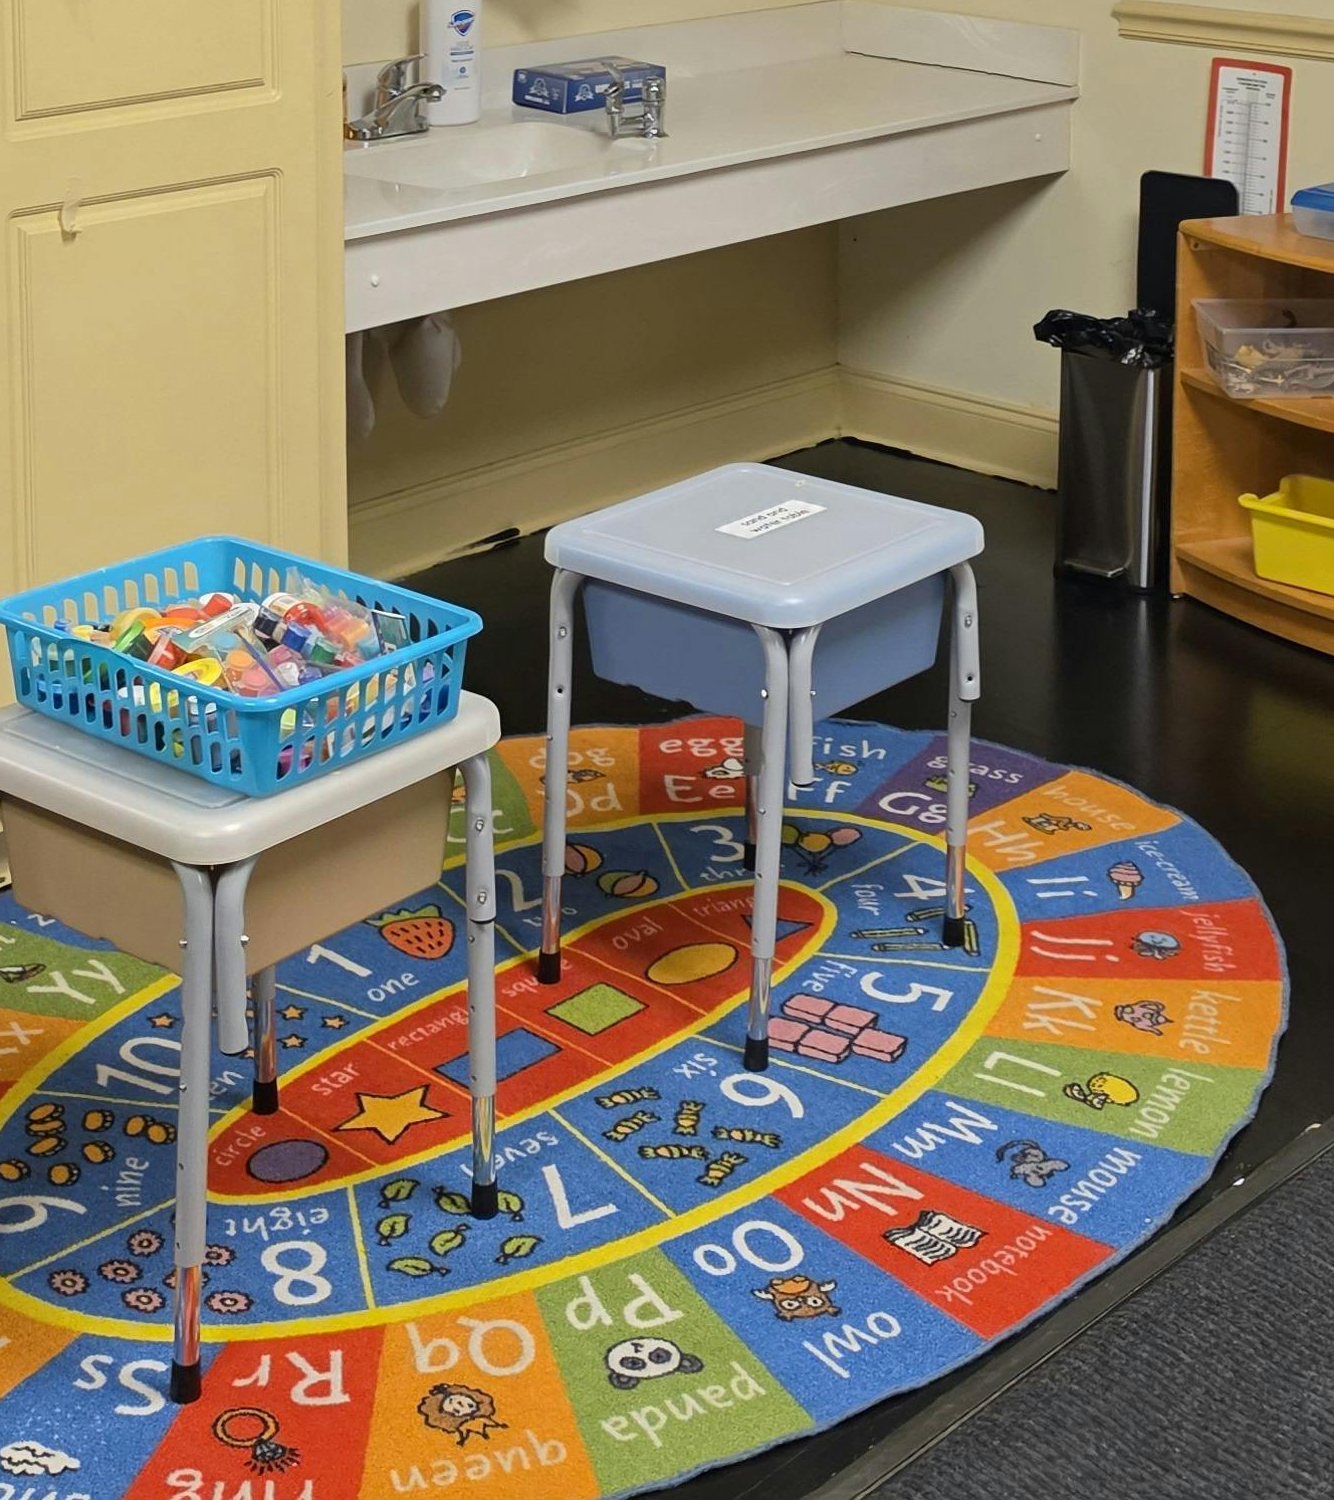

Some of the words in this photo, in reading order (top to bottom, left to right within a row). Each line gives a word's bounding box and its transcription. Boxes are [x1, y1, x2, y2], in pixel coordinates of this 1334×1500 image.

[659, 735, 744, 758] egg
[926, 754, 1024, 785] gass
[663, 773, 736, 804] Ee
[1043, 785, 1137, 831] house
[689, 823, 746, 864] 3
[966, 820, 1045, 863] Hh
[495, 869, 544, 912] 2
[1134, 839, 1200, 900] ice-cream
[523, 907, 578, 928] to
[851, 883, 883, 916] four
[612, 915, 665, 950] oval
[1178, 909, 1237, 974] jellyfish
[27, 959, 126, 1005] Yy
[307, 944, 373, 978] 1
[802, 959, 858, 992] five
[367, 971, 420, 1002] one
[860, 971, 954, 1012] 5
[387, 1006, 469, 1049] rectangl
[1022, 985, 1102, 1036] Kk
[1178, 988, 1241, 1056] kettle
[96, 1036, 182, 1094] 10
[209, 1068, 245, 1100] en
[311, 1062, 361, 1097] star
[672, 1052, 718, 1079] six
[719, 1072, 805, 1118] 6
[1128, 1065, 1214, 1139] lemon
[212, 1124, 266, 1167] circle
[892, 1101, 998, 1161] Mm
[101, 1155, 150, 1207] nine
[542, 1164, 620, 1230] 7
[802, 1161, 925, 1222] Nn
[1046, 1146, 1142, 1225] mouse
[225, 1204, 330, 1238] eight
[692, 1219, 804, 1276] Oo
[936, 1224, 1054, 1306] notebook
[259, 1240, 333, 1306] 8
[566, 1273, 684, 1331] Pp
[404, 1315, 535, 1377] Qq
[802, 1310, 902, 1379] owl
[73, 1354, 168, 1417] Ss
[232, 1348, 351, 1407] Rr
[601, 1361, 768, 1448] panda
[389, 1430, 566, 1495] queen
